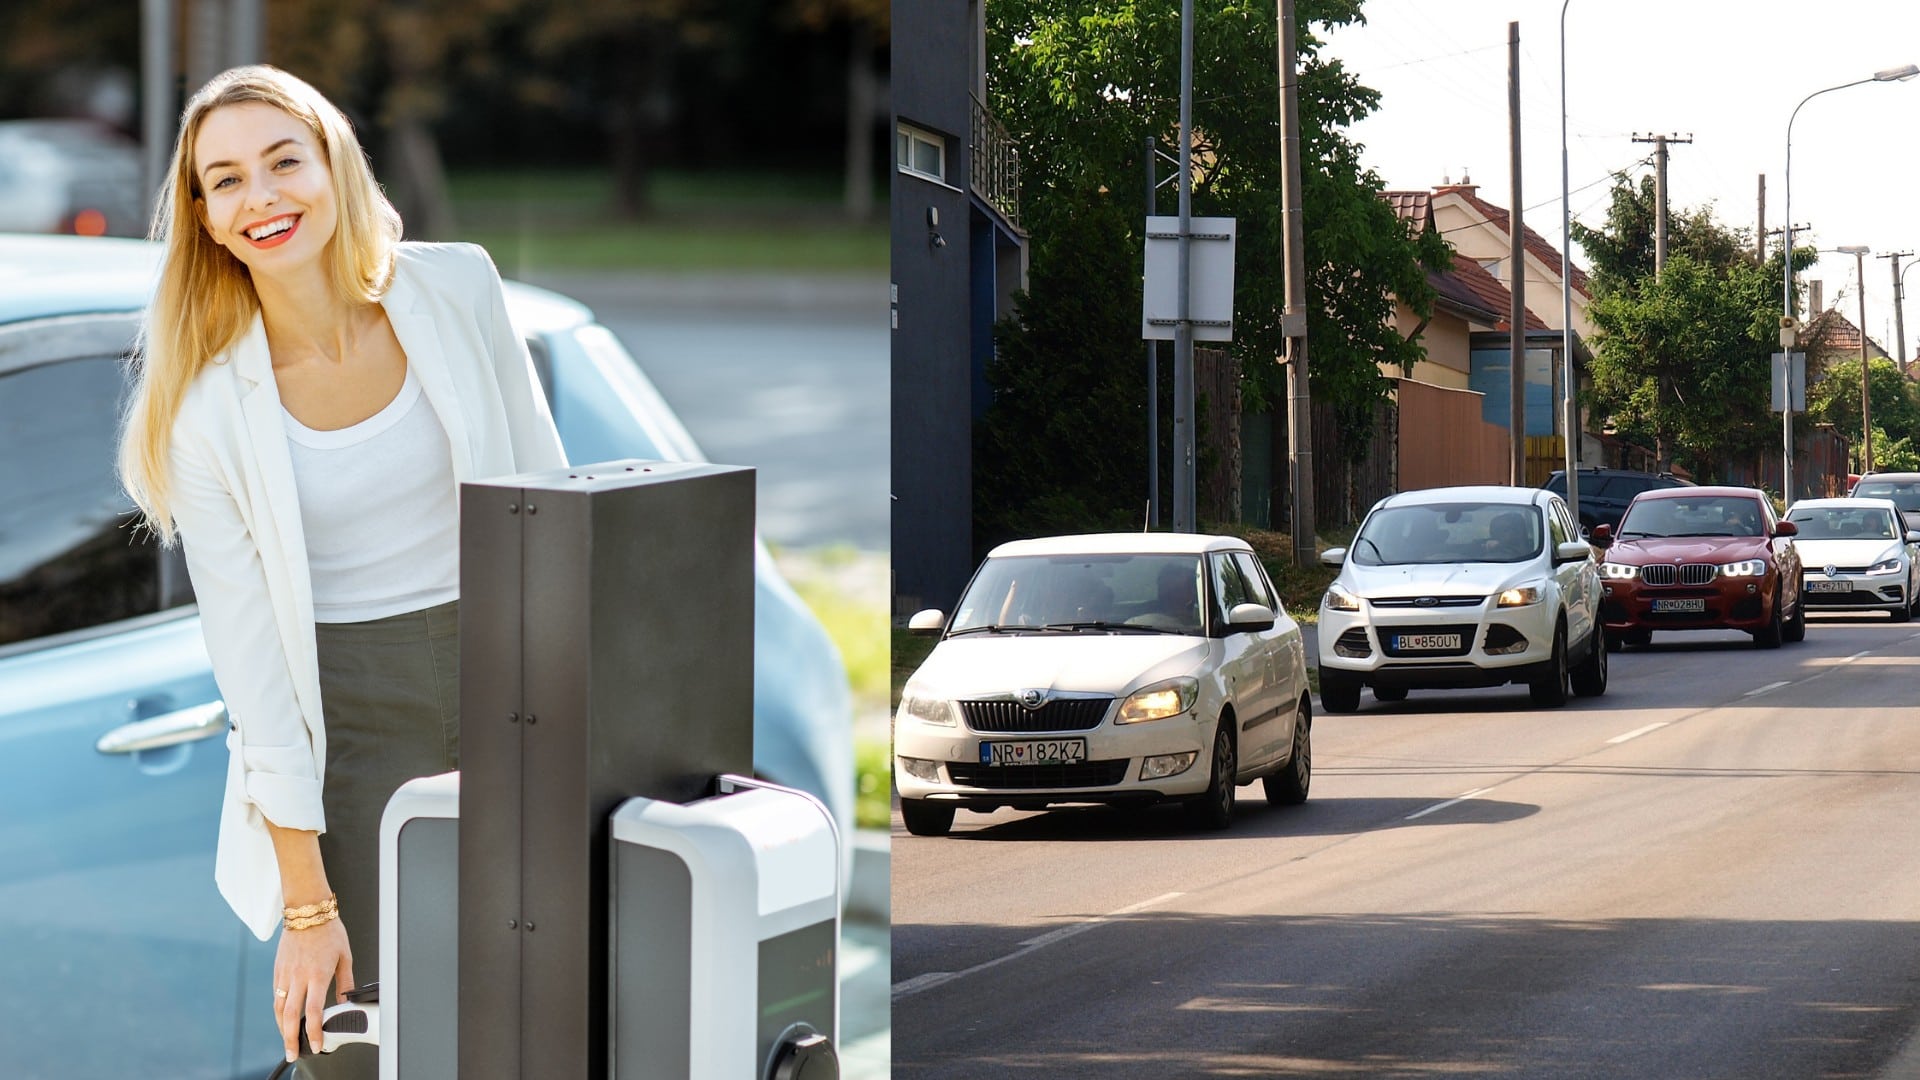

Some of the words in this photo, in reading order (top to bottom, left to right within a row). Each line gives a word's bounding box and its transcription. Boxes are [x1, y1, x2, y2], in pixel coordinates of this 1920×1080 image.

[1400, 636, 1415, 649] BL
[1421, 635, 1459, 648] 850UY
[993, 744, 1014, 762] NR
[1026, 741, 1082, 761] 182KZ
